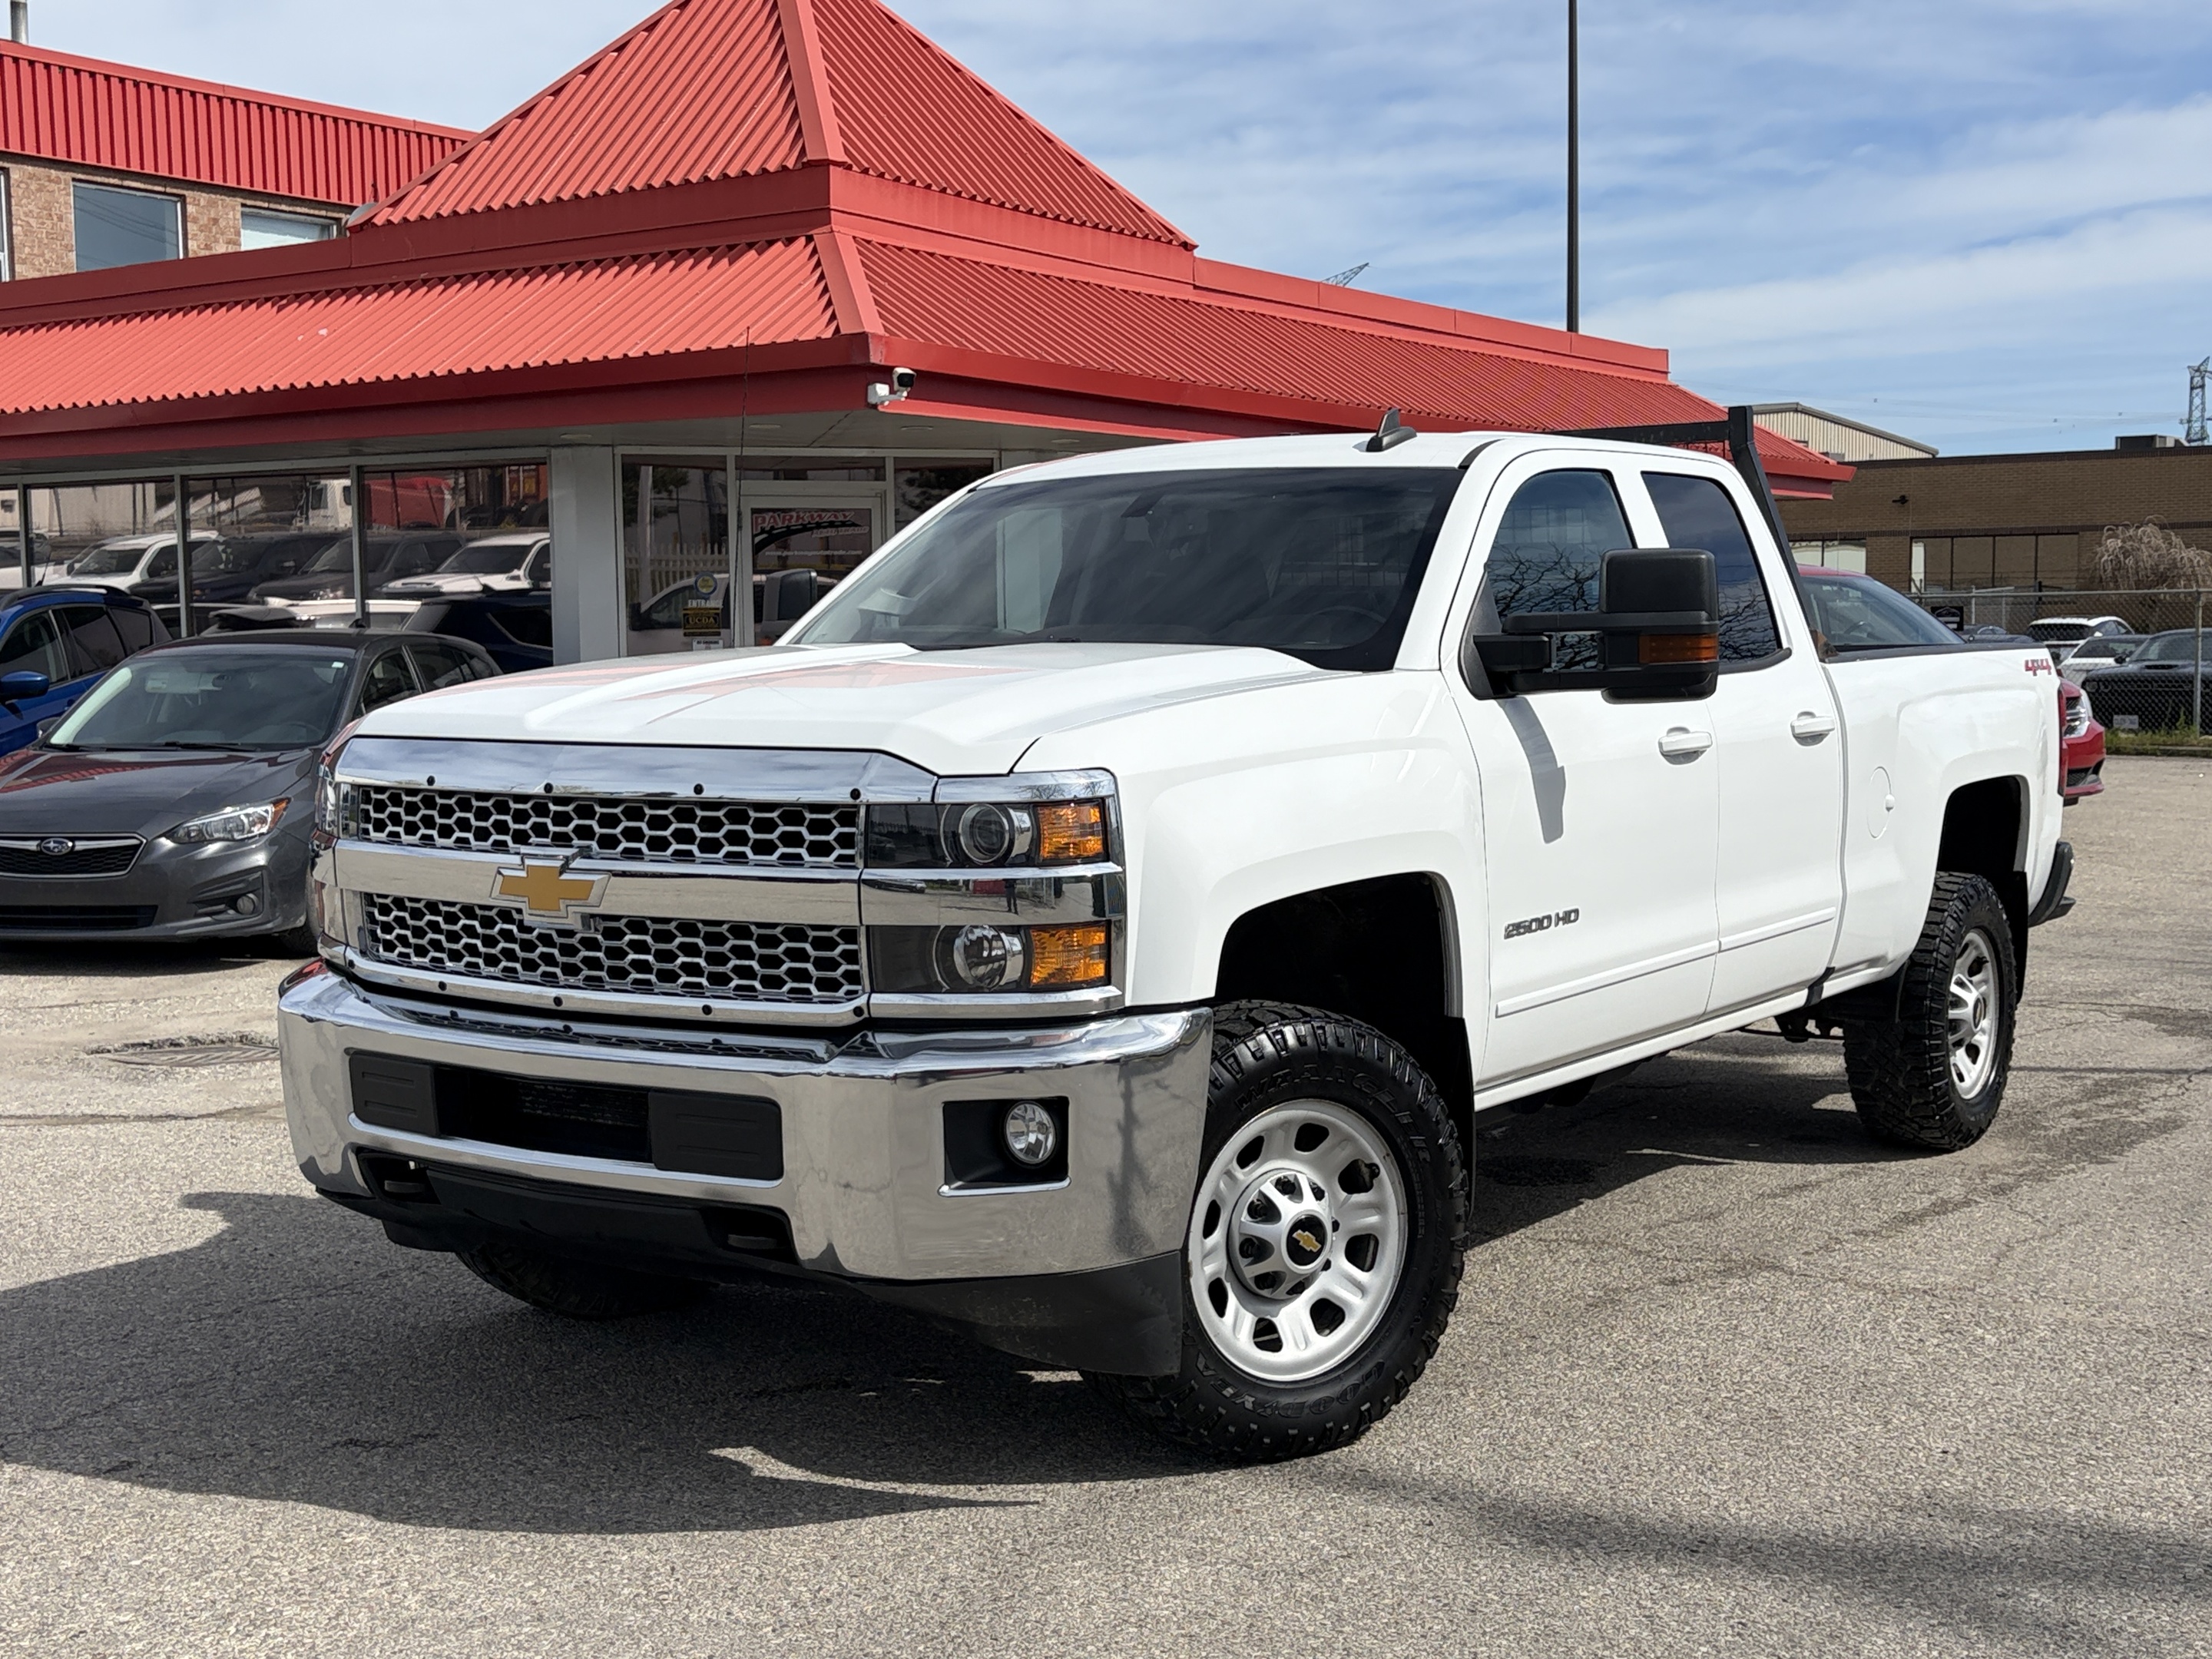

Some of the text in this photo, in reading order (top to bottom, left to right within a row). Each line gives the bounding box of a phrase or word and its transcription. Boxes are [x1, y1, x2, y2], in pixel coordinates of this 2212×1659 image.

[753, 512, 855, 534] PARKWAY
[1504, 908, 1580, 939] 2500 HD
